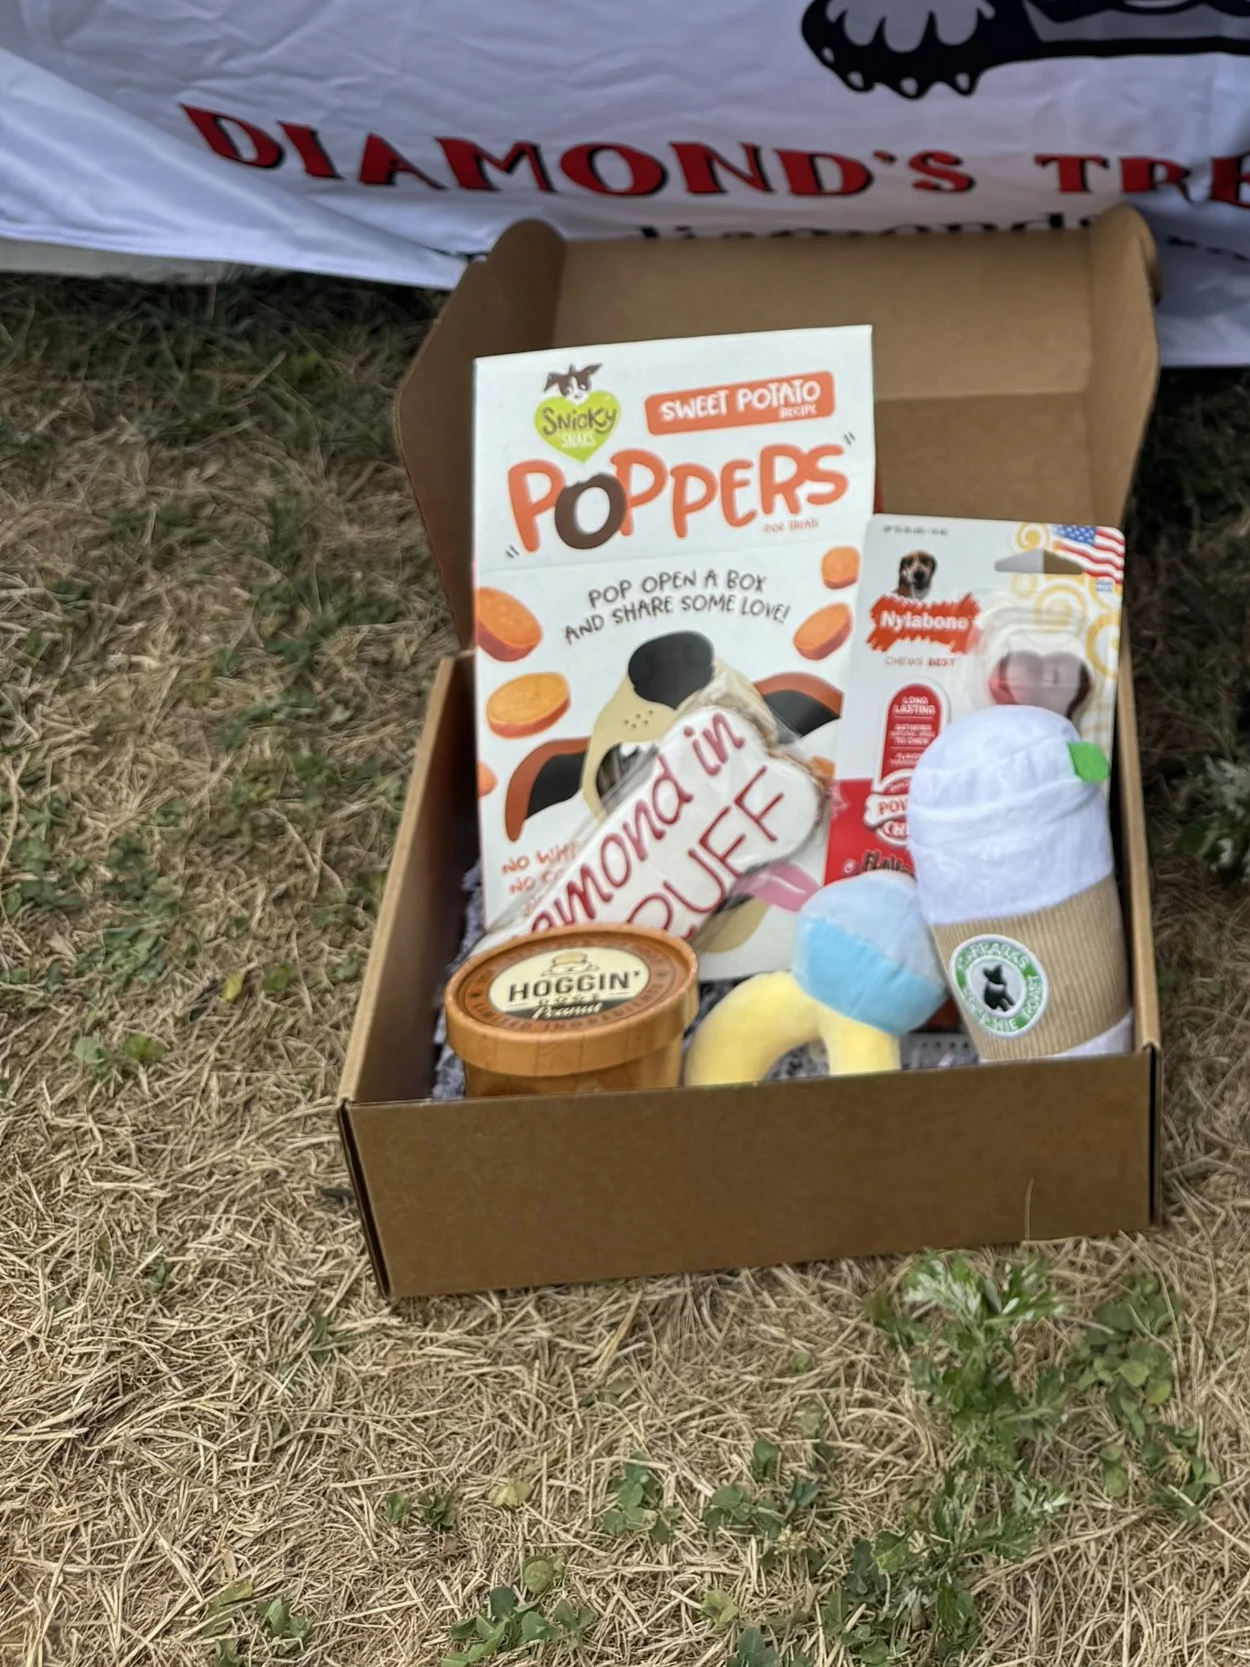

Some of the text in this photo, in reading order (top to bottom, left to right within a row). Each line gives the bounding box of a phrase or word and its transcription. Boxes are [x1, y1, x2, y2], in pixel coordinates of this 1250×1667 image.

[178, 102, 976, 198] DIAMOND'S
[658, 378, 823, 424] SWEET POTATO
[507, 443, 851, 554] POPPERS
[588, 567, 768, 609] POP OPEN A BOX
[562, 592, 792, 646] AND SHARE SOME LOVE!
[880, 609, 971, 633] Nylabone
[683, 711, 749, 776] in
[502, 855, 530, 875] NO
[508, 969, 642, 1003] HOGGIN'
